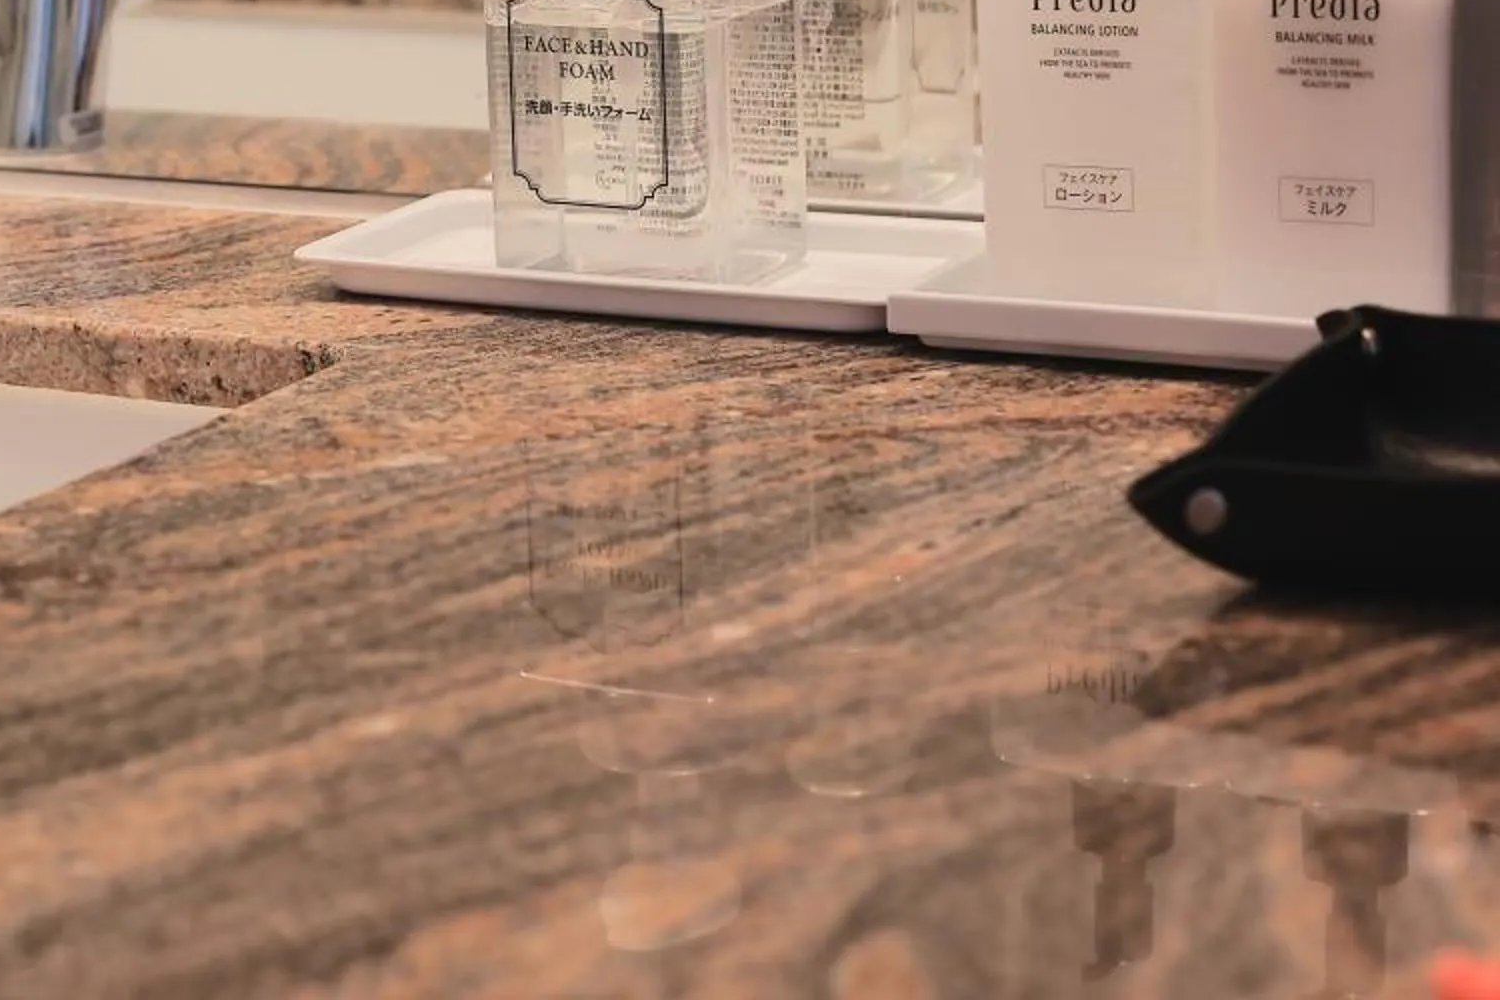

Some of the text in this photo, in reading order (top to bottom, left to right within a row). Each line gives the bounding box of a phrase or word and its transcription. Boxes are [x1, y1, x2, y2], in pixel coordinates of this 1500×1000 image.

[1031, 23, 1139, 37] BALANCING LOTION
[1275, 31, 1375, 46] BALANCING MILK
[559, 61, 615, 81] FOAM
[1055, 187, 1123, 205] ローション
[1307, 200, 1348, 217] ミルク
